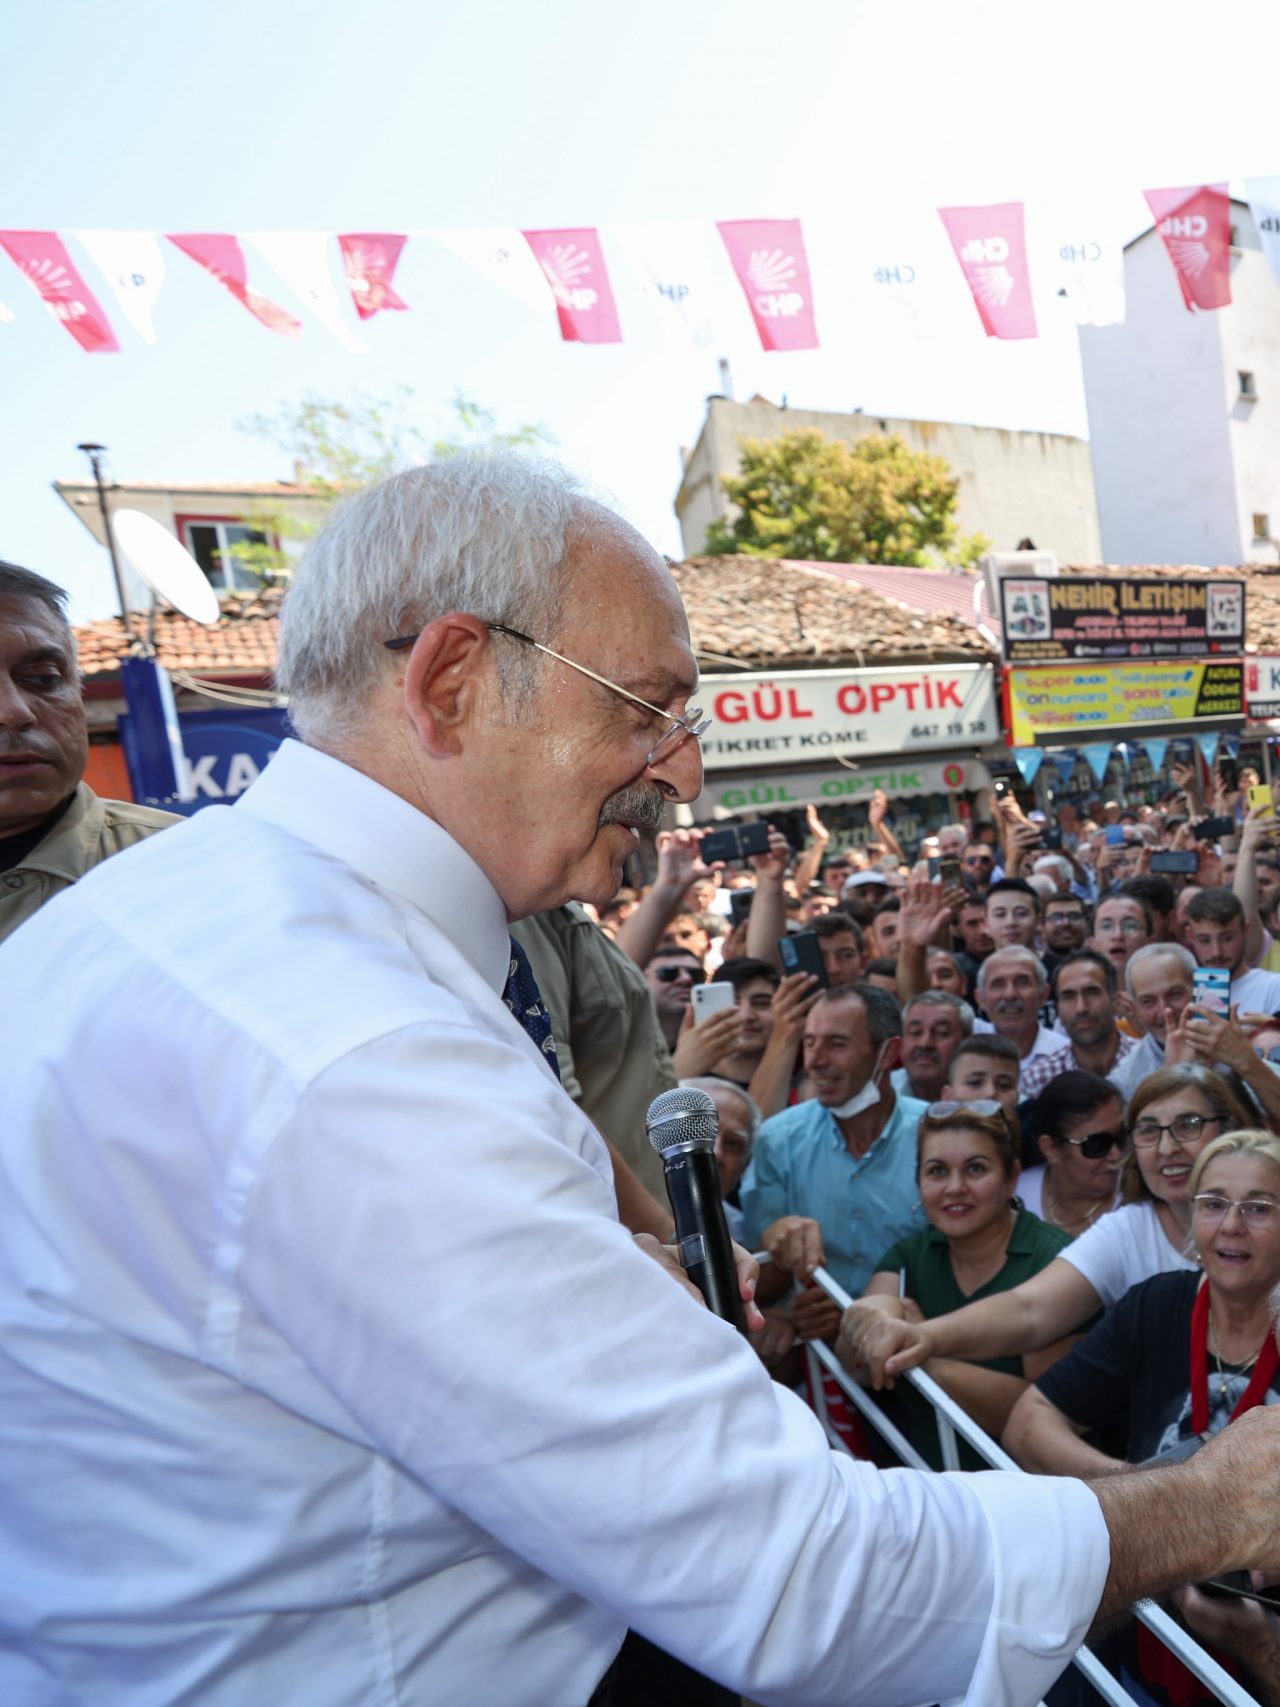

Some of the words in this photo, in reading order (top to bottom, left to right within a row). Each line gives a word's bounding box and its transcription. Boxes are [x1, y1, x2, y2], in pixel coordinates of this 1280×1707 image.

[873, 264, 916, 284] CHP
[1050, 581, 1119, 616] NEHİR
[713, 681, 813, 724] GÜL
[836, 674, 964, 716] OPTİK
[720, 782, 797, 808] GÜL
[821, 766, 922, 798] OPTİK
